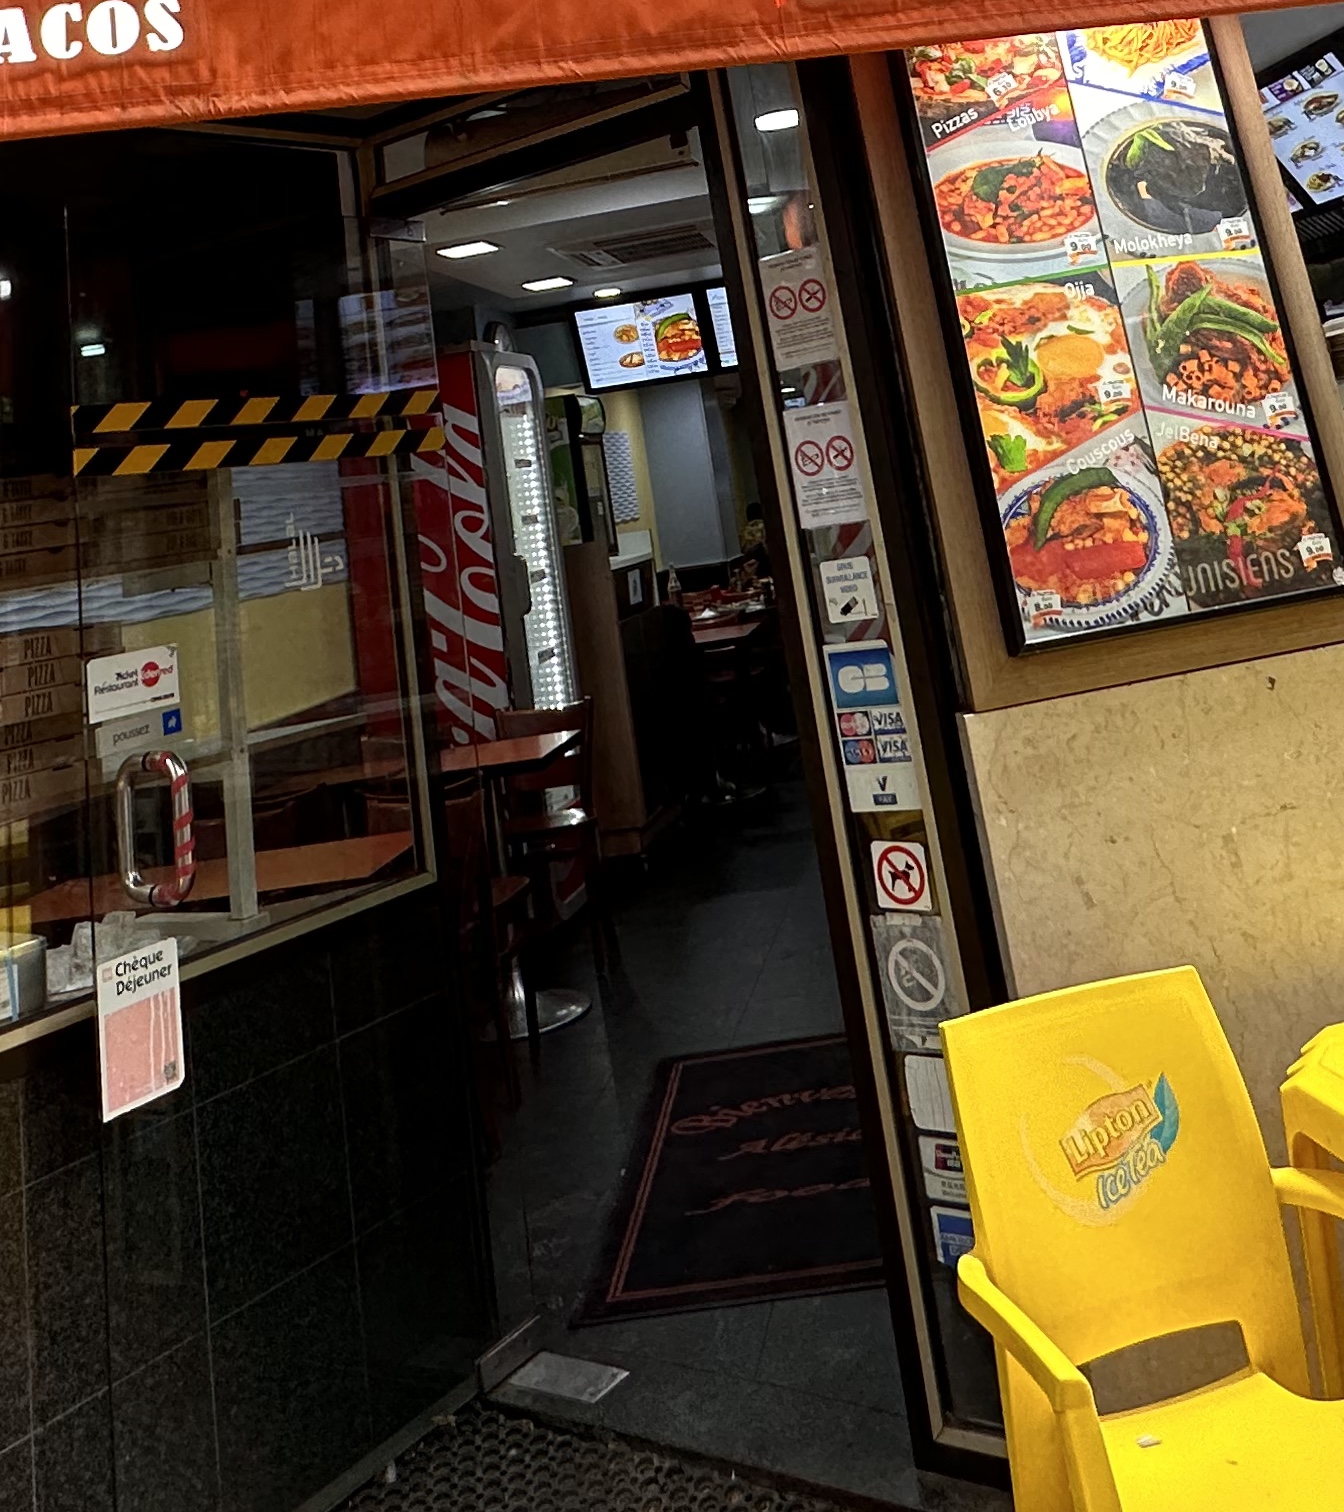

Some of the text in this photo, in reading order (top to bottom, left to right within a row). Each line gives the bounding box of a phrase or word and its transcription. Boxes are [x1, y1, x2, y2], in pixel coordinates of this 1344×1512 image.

[931, 107, 979, 138] Pizzas
[1007, 103, 1059, 132] Loubya
[1114, 232, 1193, 254] Molokheya
[1162, 384, 1256, 419] Makarouna
[1066, 428, 1136, 475] Couscous
[24, 636, 51, 659] PIZZA
[27, 663, 55, 688] PIZZA
[25, 692, 53, 718] PIZZA
[873, 711, 904, 727] VISA
[113, 724, 150, 746] poussez
[881, 739, 909, 755] VISA
[115, 950, 164, 977] Chèque
[116, 964, 173, 996] Déjeuner
[1065, 1096, 1152, 1166] Lipton
